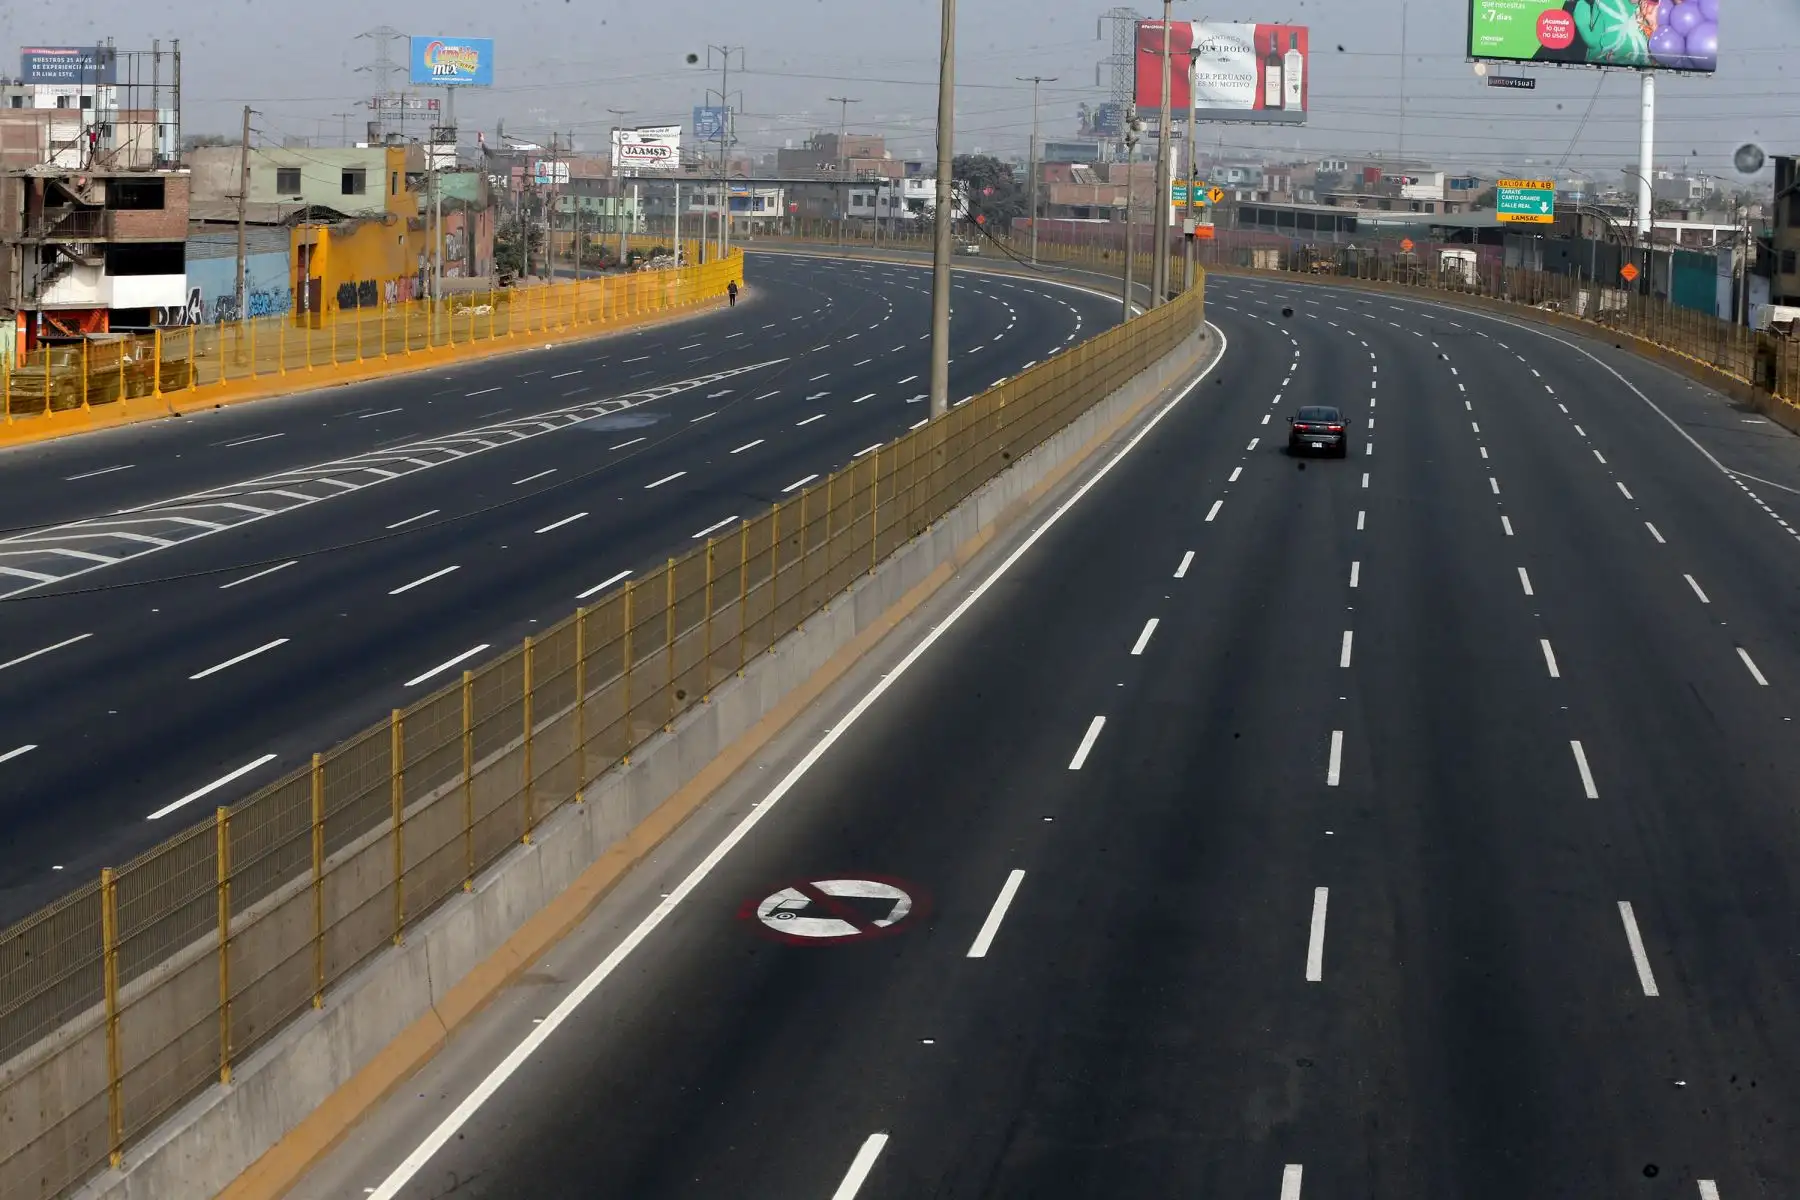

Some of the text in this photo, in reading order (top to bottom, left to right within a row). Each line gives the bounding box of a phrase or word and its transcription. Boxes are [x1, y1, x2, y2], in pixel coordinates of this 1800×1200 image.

[1495, 2, 1525, 10] necesitas
[1488, 9, 1496, 22] 7
[432, 63, 458, 75] mix
[1212, 73, 1253, 81] PERUANO
[625, 147, 667, 157] JAAMSA
[1499, 180, 1523, 188] SALIDA
